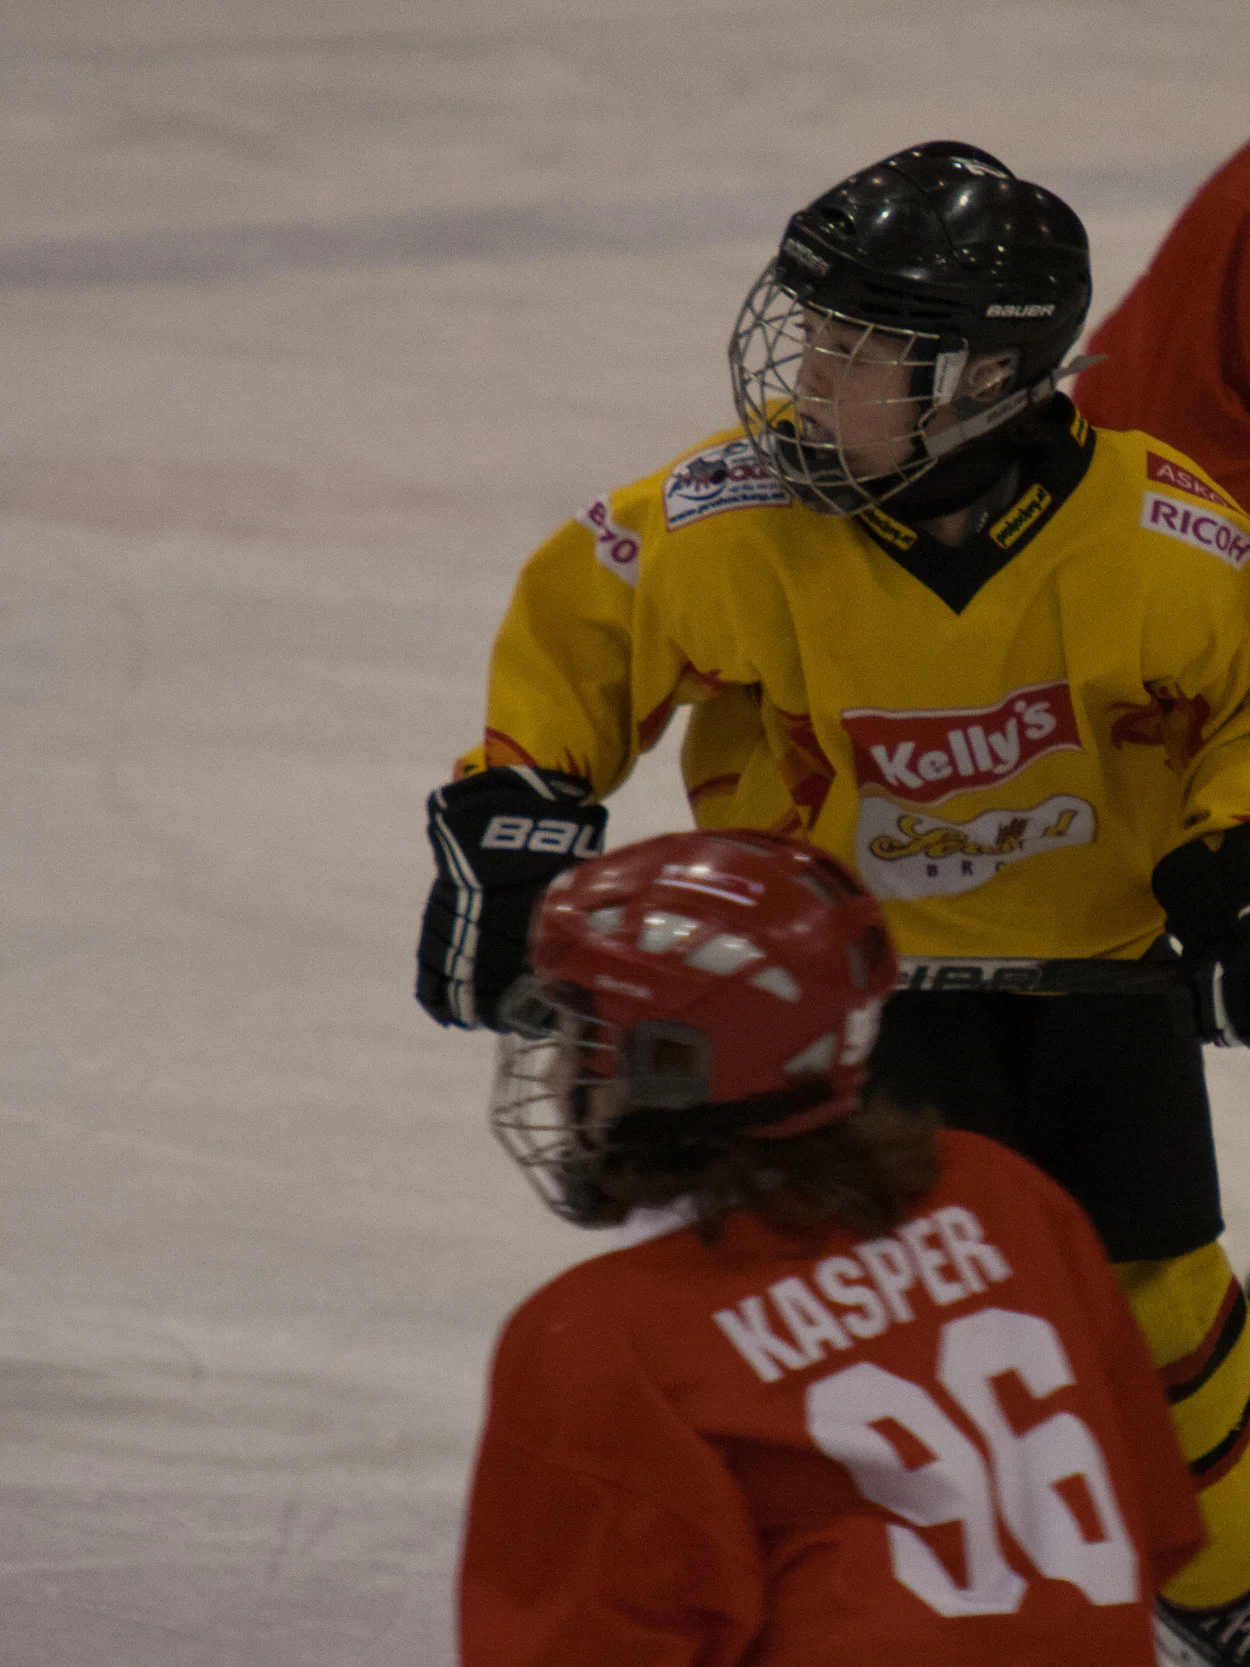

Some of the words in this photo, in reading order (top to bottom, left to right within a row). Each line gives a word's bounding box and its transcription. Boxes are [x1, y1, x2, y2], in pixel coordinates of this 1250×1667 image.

[868, 700, 1057, 790] Kelly's
[711, 1205, 1013, 1383] KASPER
[805, 1306, 1140, 1618] 96
